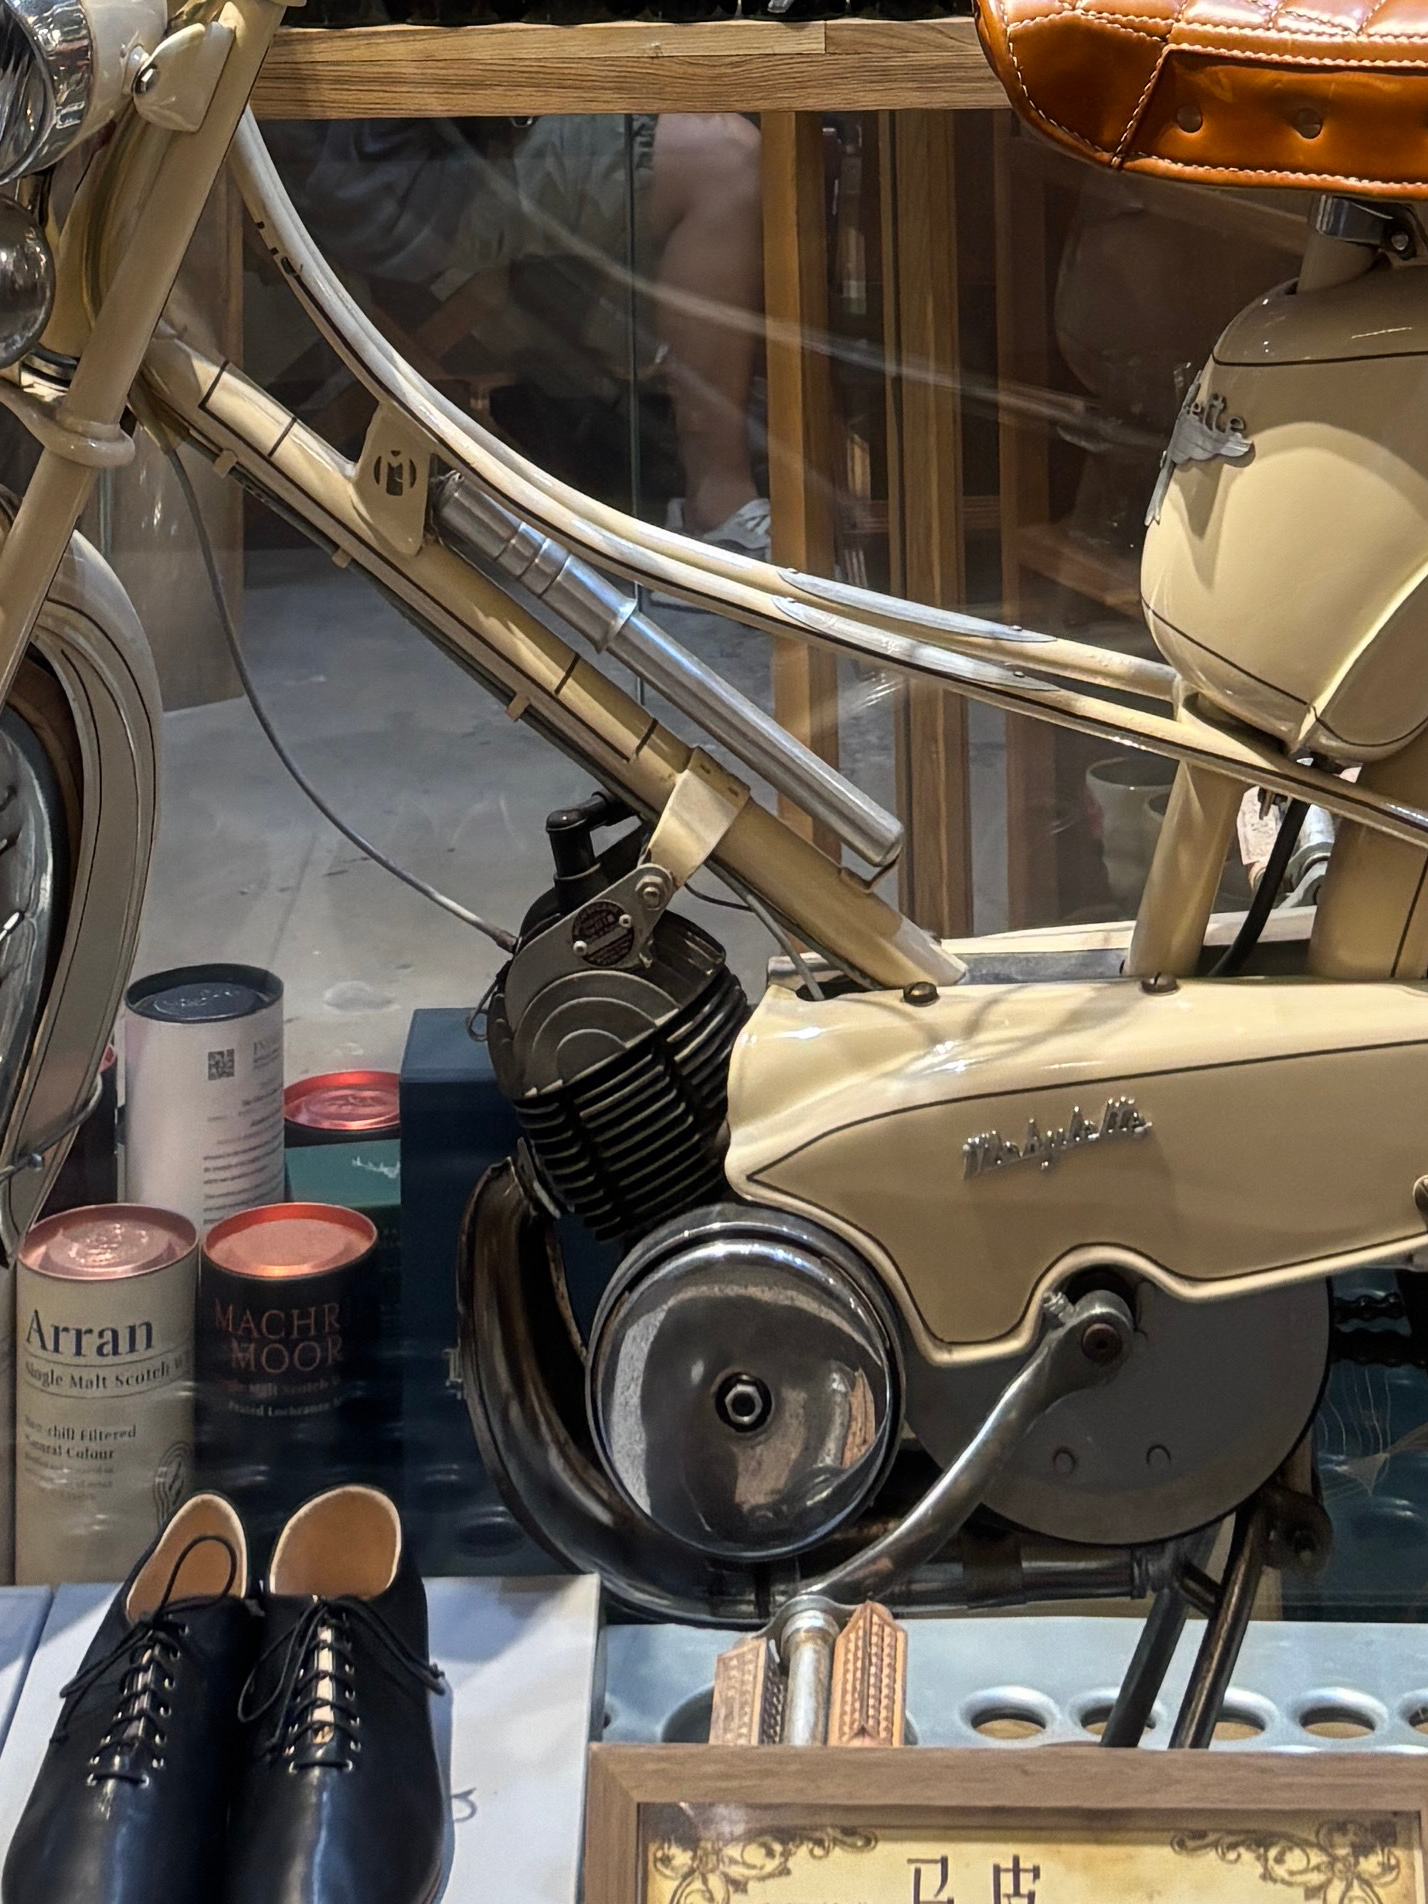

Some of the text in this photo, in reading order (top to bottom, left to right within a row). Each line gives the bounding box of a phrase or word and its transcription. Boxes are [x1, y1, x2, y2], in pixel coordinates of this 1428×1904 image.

[26, 1310, 154, 1357] Arran
[70, 1373, 107, 1390] Malt
[115, 1364, 170, 1387] Scotch
